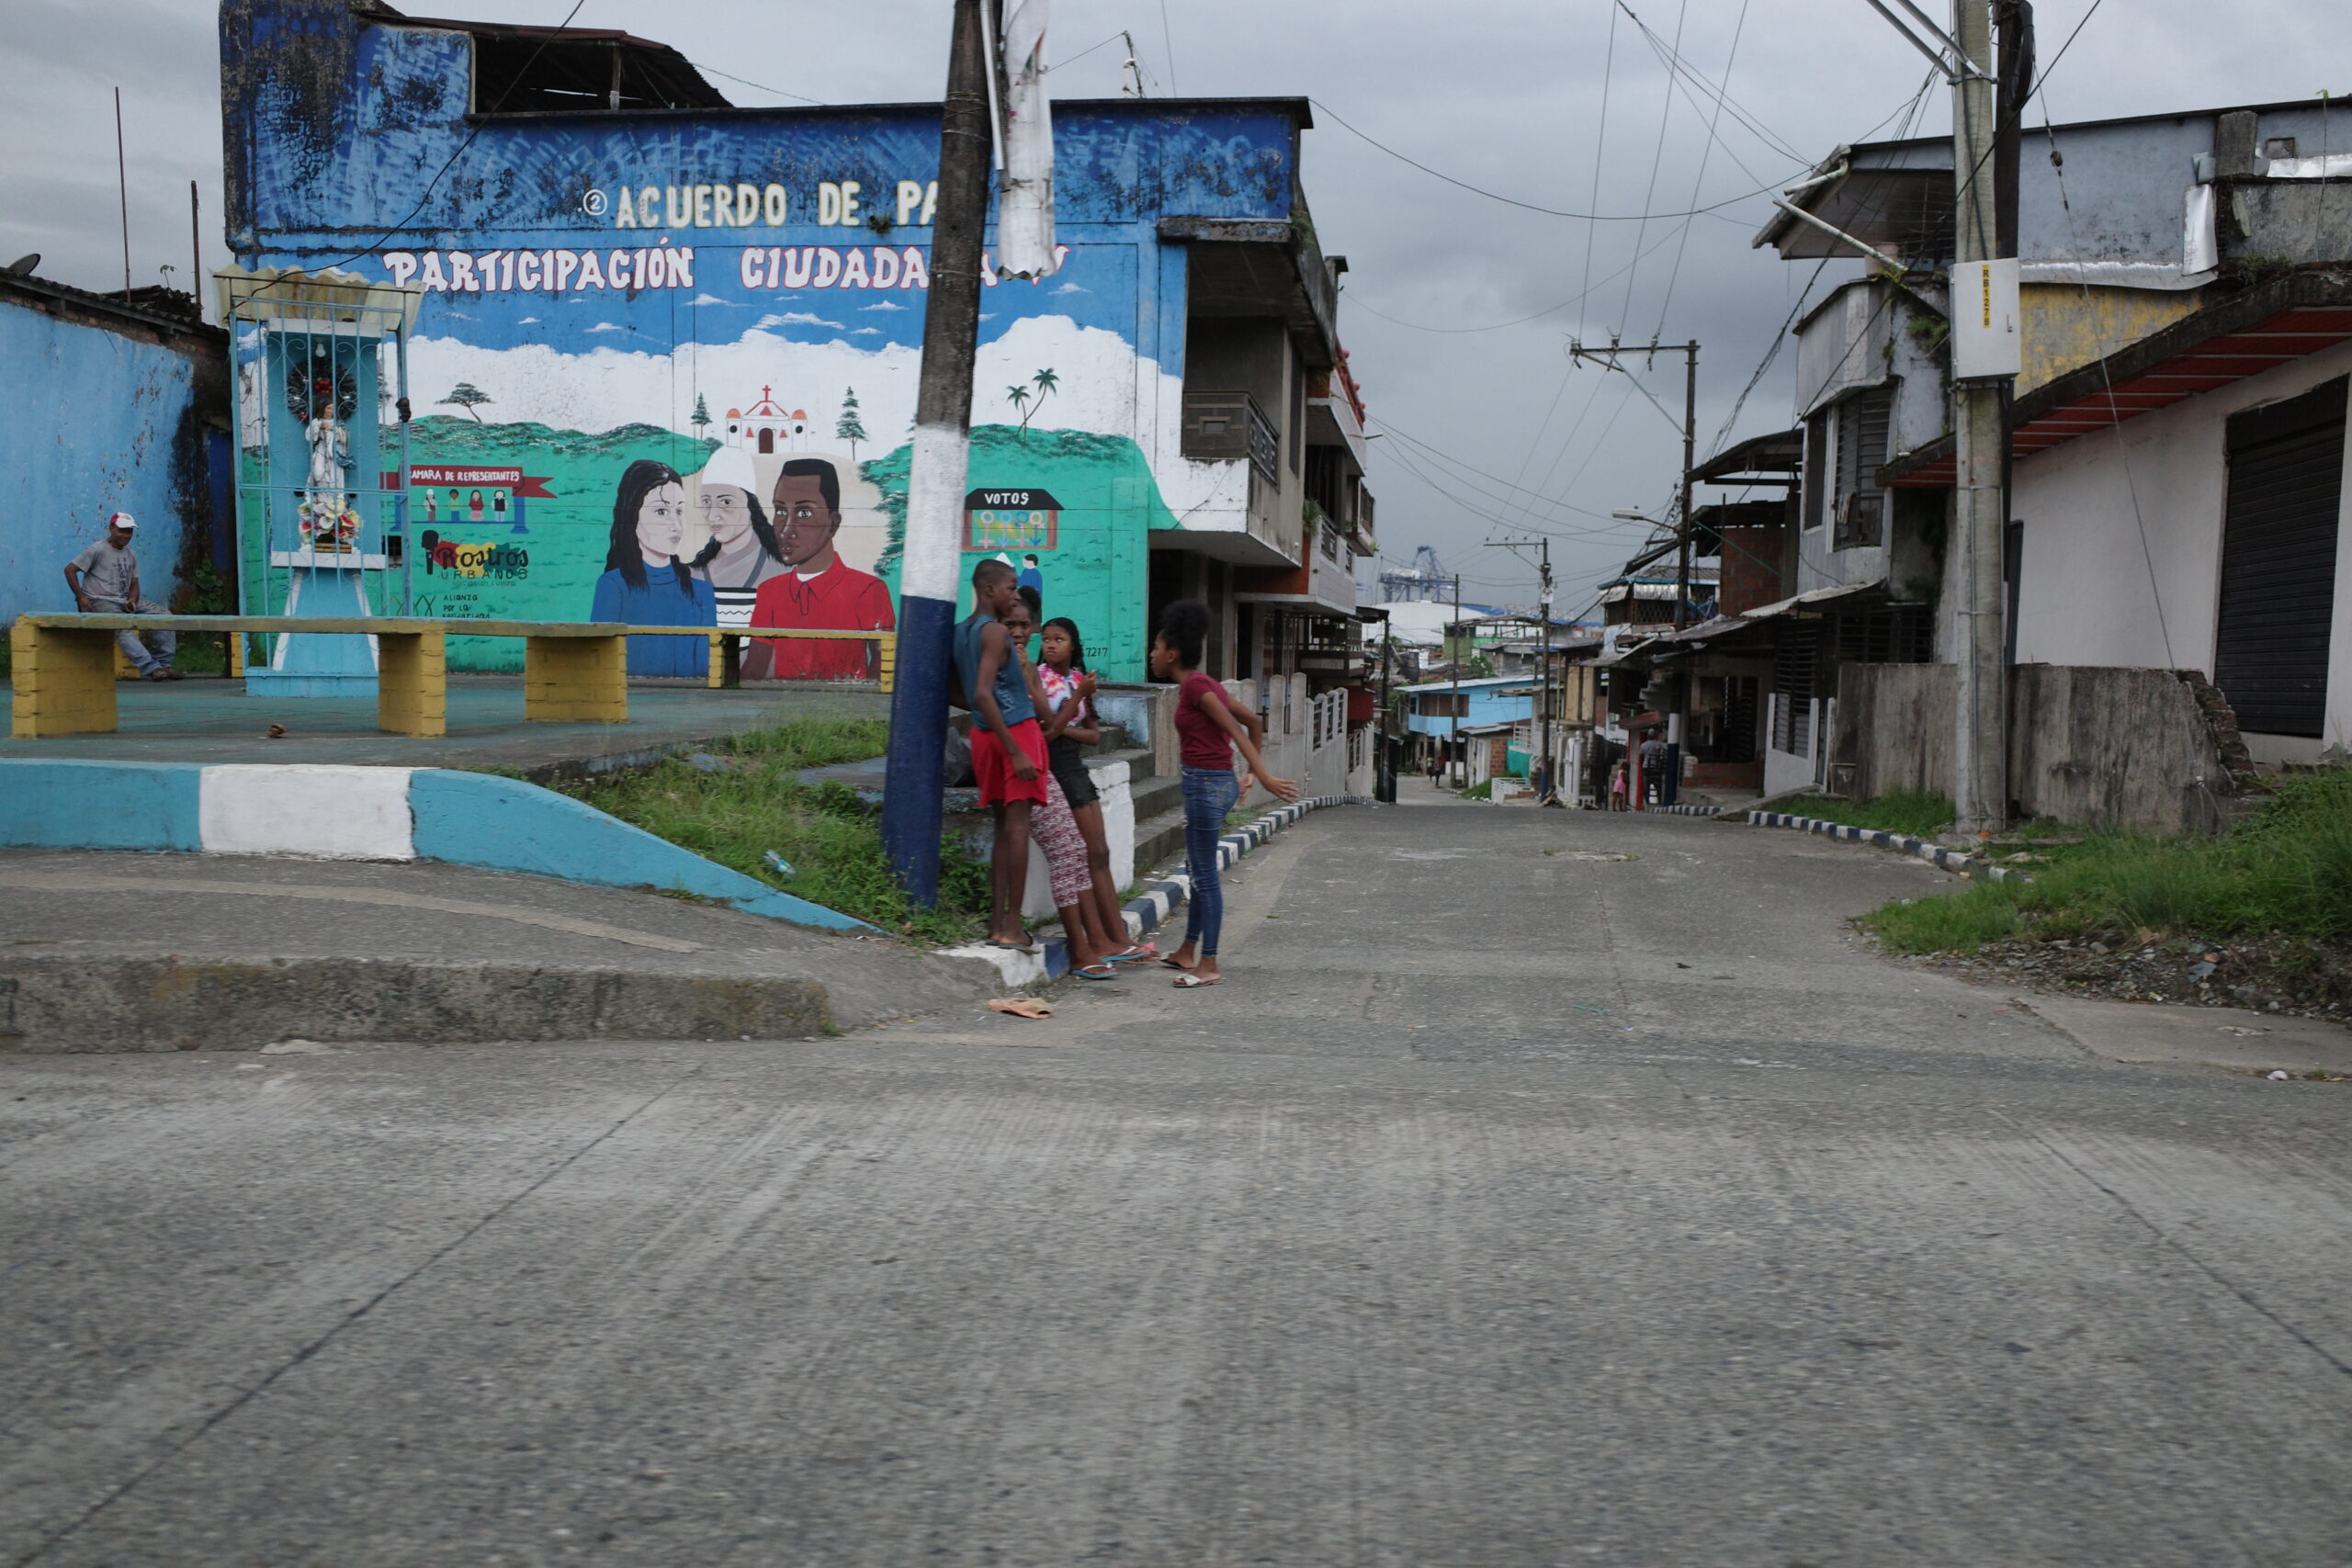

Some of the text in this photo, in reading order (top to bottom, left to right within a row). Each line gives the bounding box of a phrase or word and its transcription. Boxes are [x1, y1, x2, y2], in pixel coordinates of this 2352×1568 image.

[616, 183, 786, 229] ACUERDO
[819, 180, 861, 226] DE
[897, 180, 939, 225] PA
[382, 236, 695, 293] PARTICIPACIÓN
[740, 245, 999, 290] CIUDADAA
[445, 471, 455, 481] DE
[457, 471, 520, 482] REPRESENTANTES
[984, 492, 1029, 505] VOTOS
[435, 547, 529, 570] Rostros
[441, 569, 528, 580] URBANOS
[1085, 647, 1108, 658] 7217
